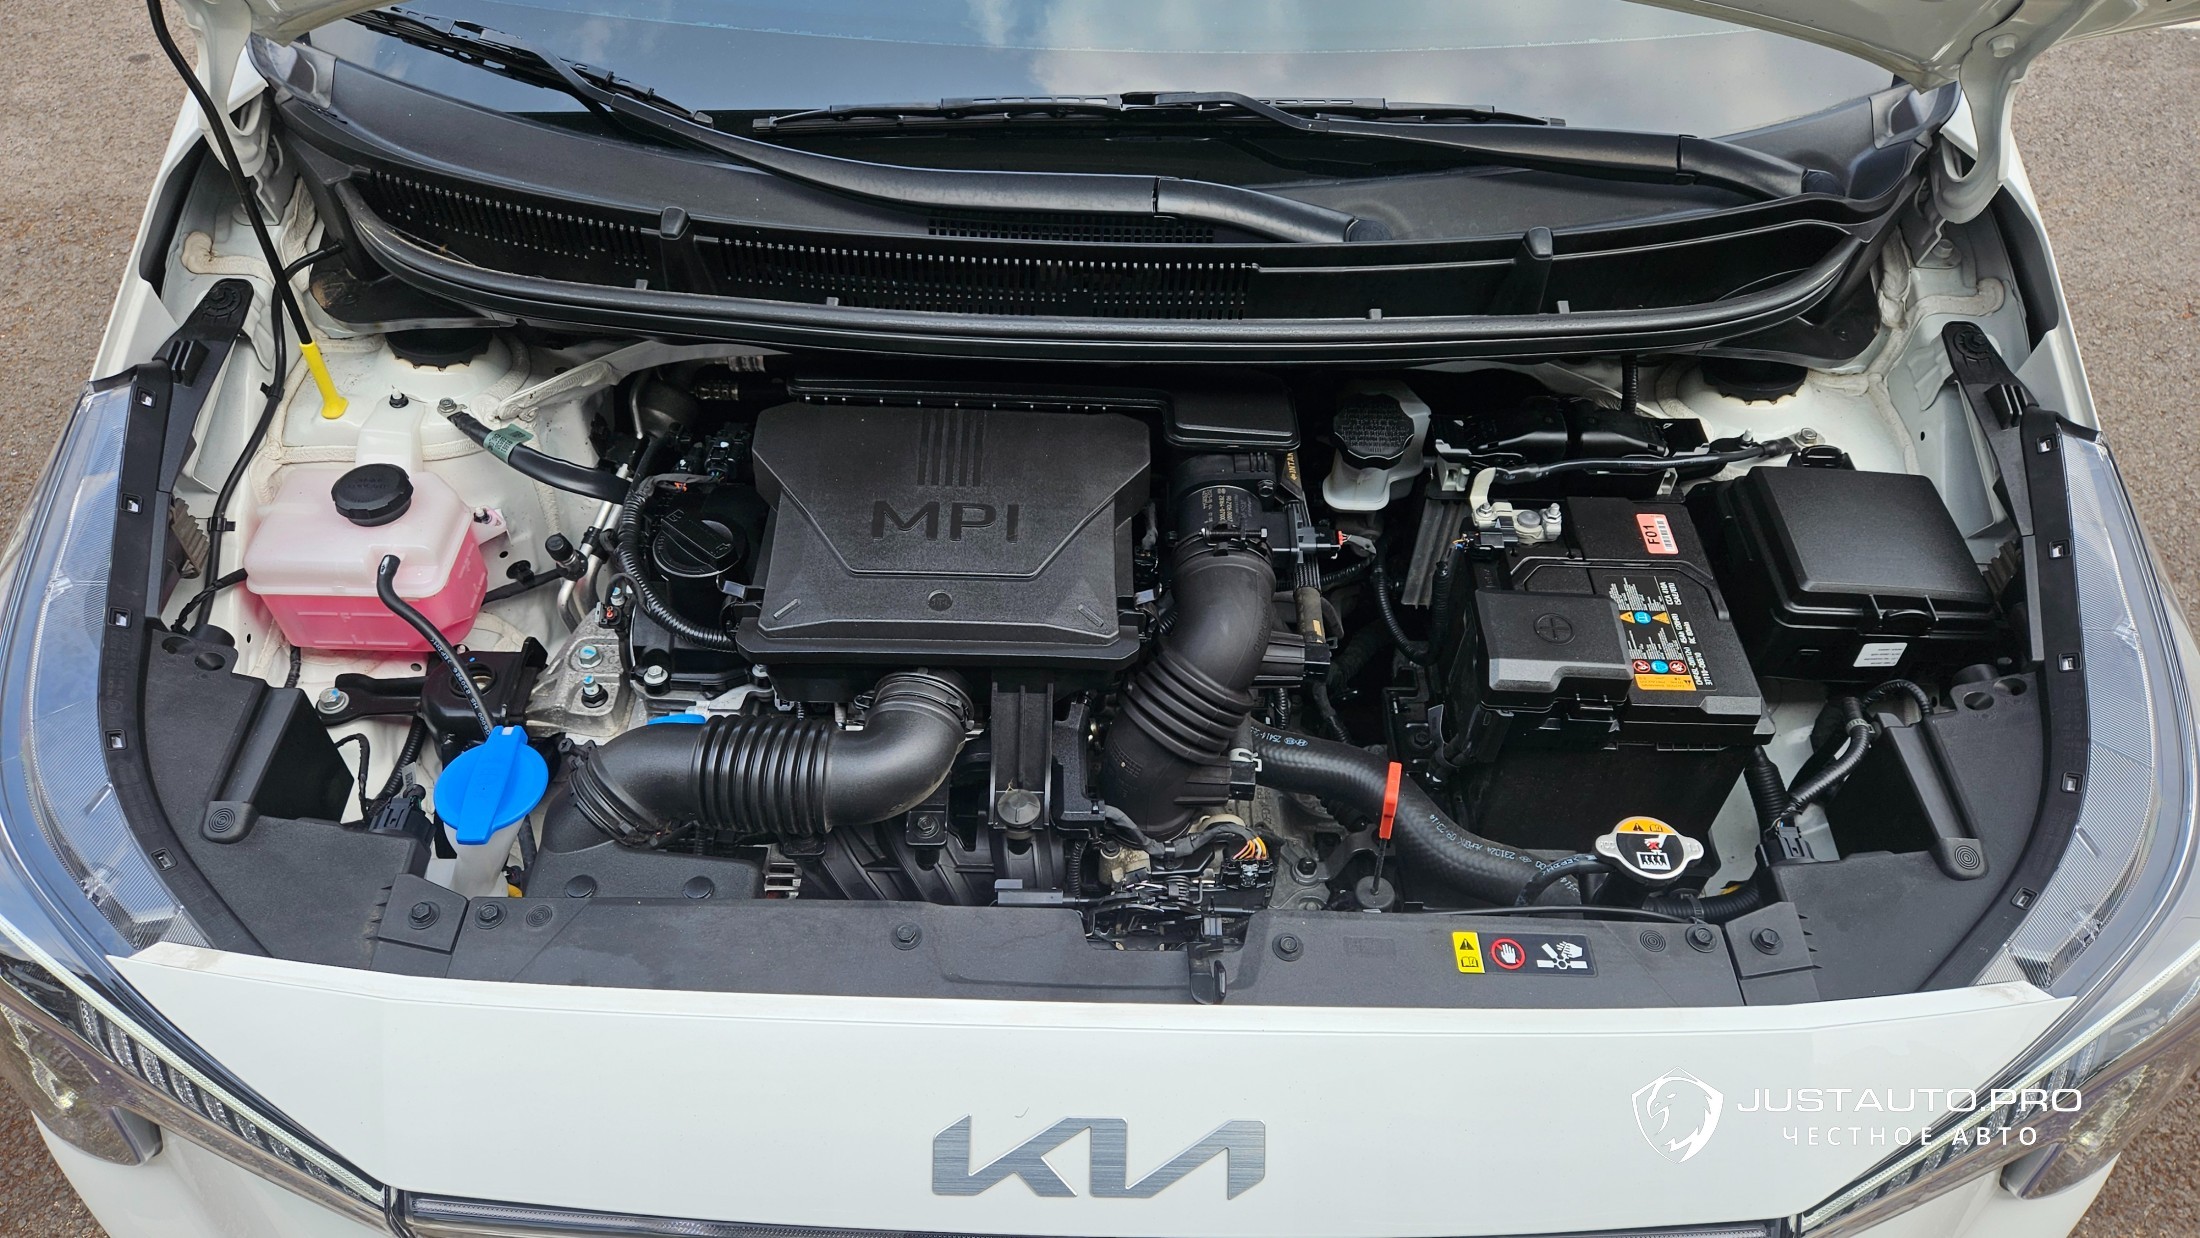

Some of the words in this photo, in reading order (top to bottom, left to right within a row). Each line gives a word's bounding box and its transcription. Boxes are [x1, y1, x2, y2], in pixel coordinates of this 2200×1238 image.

[871, 500, 1021, 544] MPI
[1643, 525, 1660, 544] F01
[933, 1114, 1266, 1200] KIA
